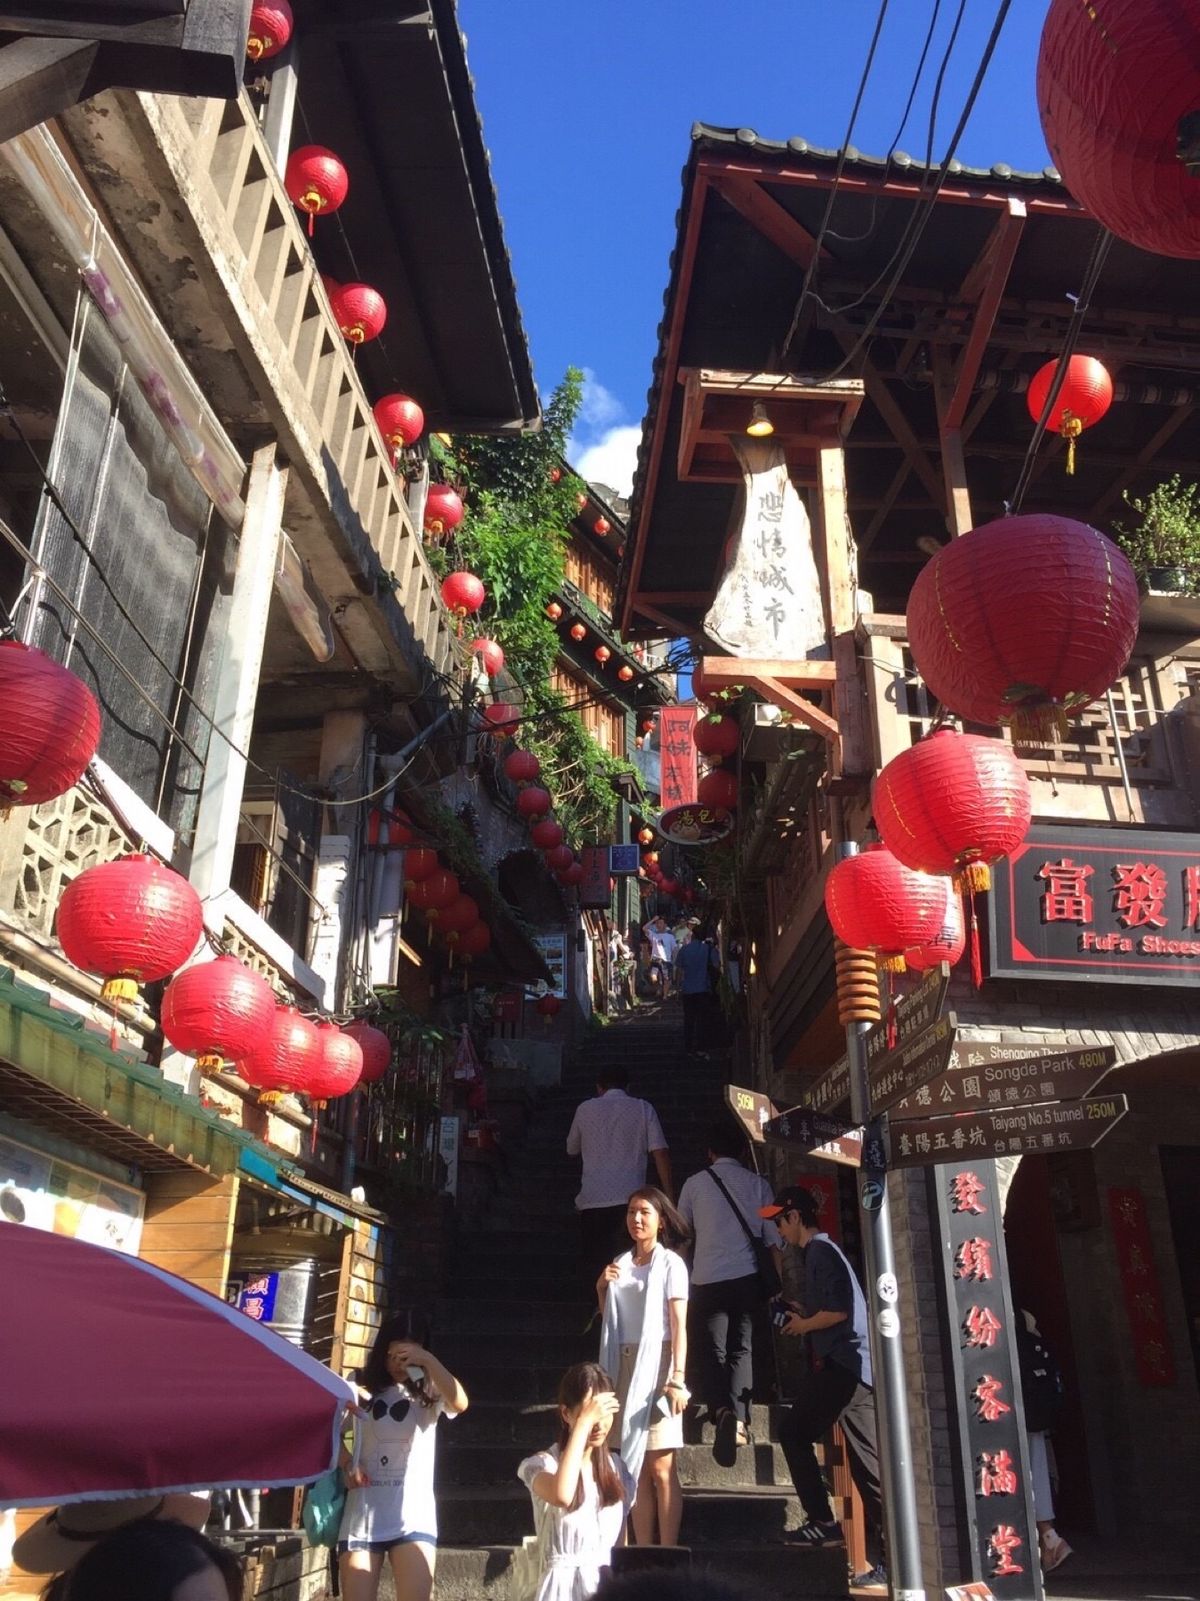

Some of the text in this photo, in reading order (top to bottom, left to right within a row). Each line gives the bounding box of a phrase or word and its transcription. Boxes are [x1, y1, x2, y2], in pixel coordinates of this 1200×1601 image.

[753, 491, 795, 641] 悲情城市
[1082, 931, 1133, 951] FuFa
[985, 1052, 1106, 1082] Songde Park 480M
[990, 1101, 1116, 1133] Taiyang No.5 tunnel 250M
[899, 1126, 987, 1156] 臺陽五番坑
[994, 1132, 1073, 1153] 台陽五番坑
